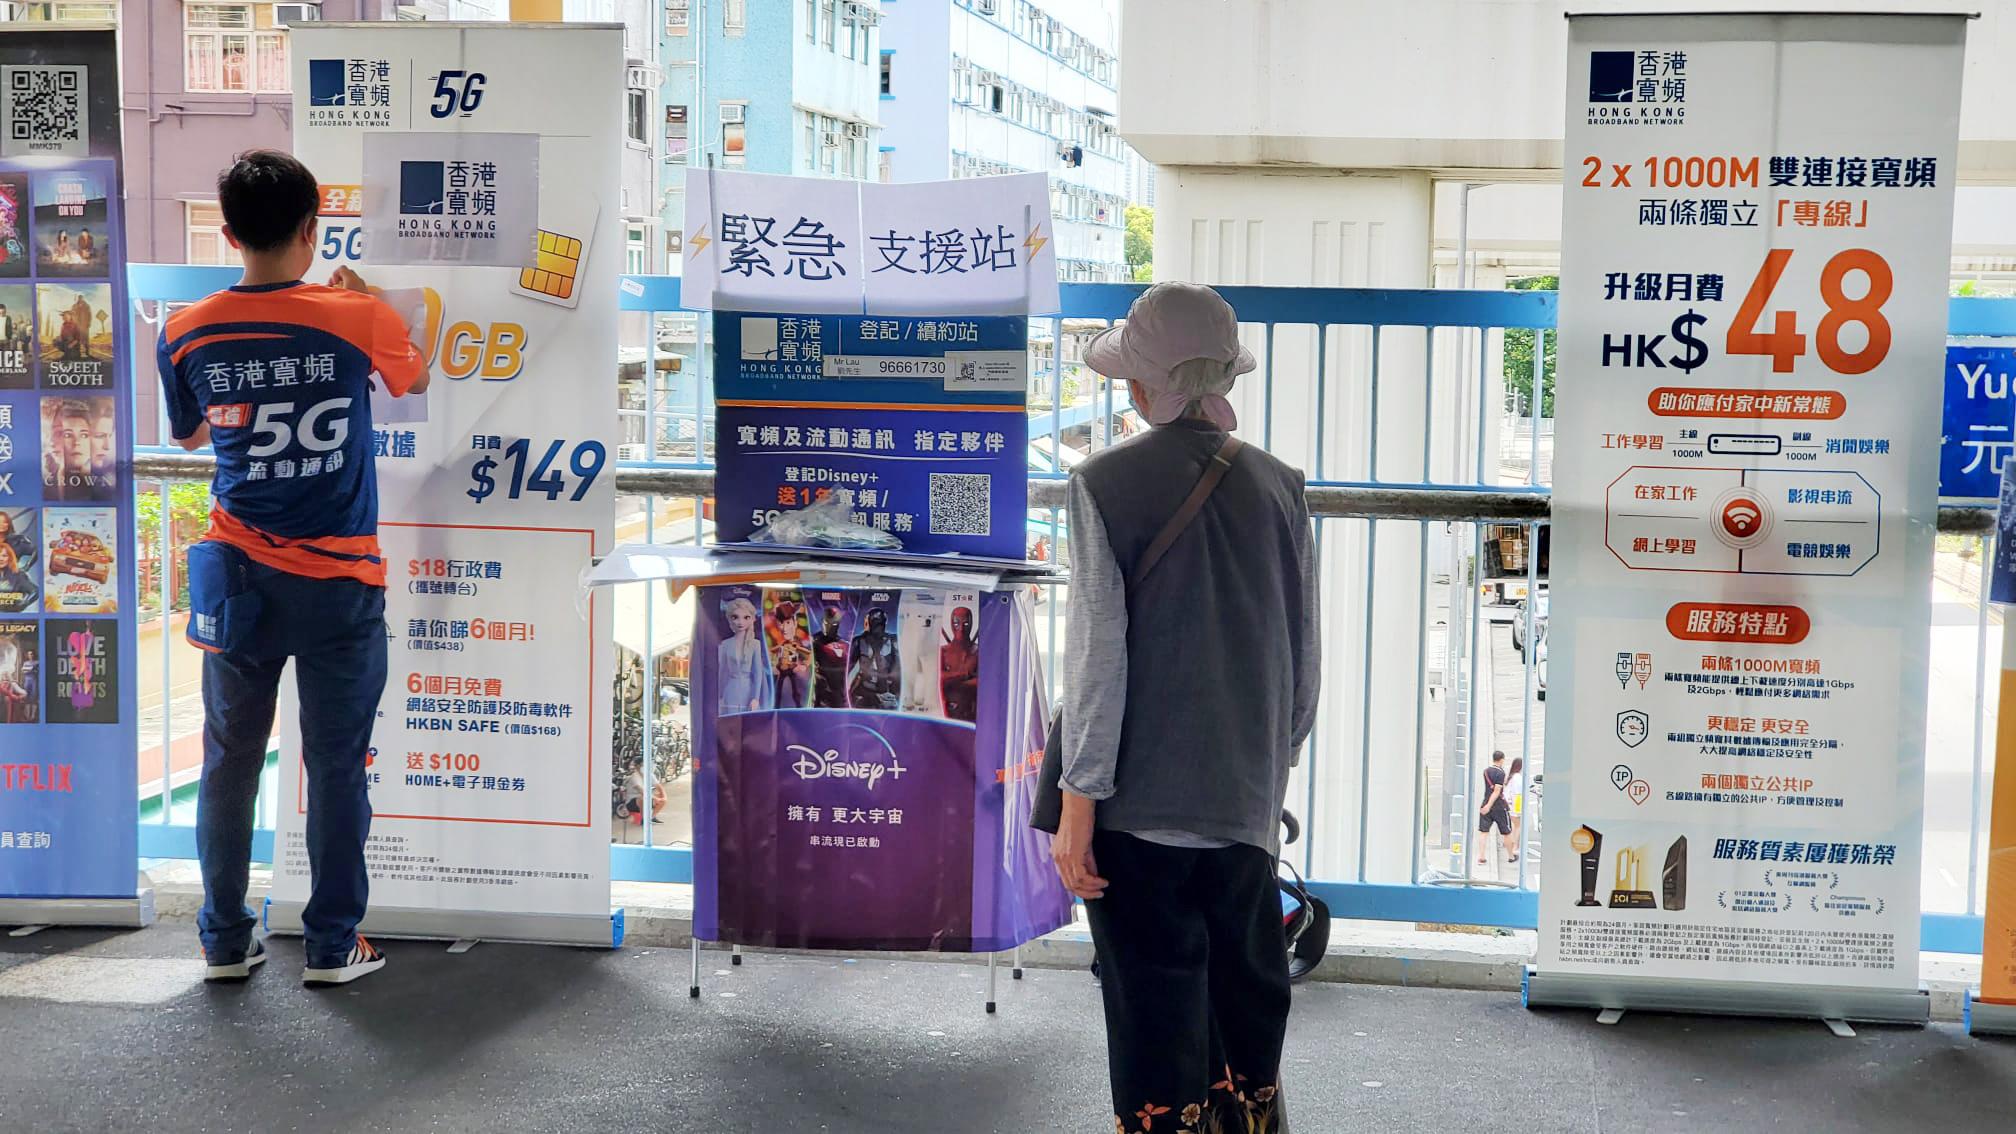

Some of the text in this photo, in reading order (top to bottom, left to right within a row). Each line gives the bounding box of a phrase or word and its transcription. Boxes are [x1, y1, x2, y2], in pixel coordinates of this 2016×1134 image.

[347, 59, 391, 83] 香港
[1636, 50, 1688, 77] 香港
[347, 84, 391, 107] 寬頻
[430, 70, 487, 119] 5G
[1635, 77, 1687, 103] 寬頻
[309, 110, 391, 120] HONG KONG
[1587, 107, 1686, 118] HONG KONG
[446, 161, 497, 188] 香港
[1581, 156, 1937, 189] 2 x 1000M 雙連接寬頻
[446, 188, 497, 216] 寬頻
[1638, 199, 1759, 227] 兩條獨立
[398, 219, 497, 231] HONG KONG
[453, 231, 496, 239] NETWORK
[720, 212, 1018, 281] 緊急 支援站
[1603, 272, 1724, 302] 升級月費
[1601, 248, 1894, 375] HK$ 48
[779, 317, 823, 341] 香港
[859, 320, 900, 341] 登記
[916, 320, 979, 343] 續約站
[779, 341, 823, 362] 寬頻
[834, 358, 860, 366] Mr Lau
[50, 361, 102, 374] SWEET
[203, 353, 336, 393] 香港寬頻
[740, 364, 823, 374] HONG KONG
[879, 361, 945, 374] 96661730
[48, 374, 104, 386] TOOTH
[1957, 363, 2016, 399] Yu
[1657, 392, 1833, 415] 助你應付家中新常態
[246, 397, 353, 458] 5G
[472, 435, 502, 450] 月費
[736, 425, 1005, 453] 寬頻及流動通訊 指定夥伴
[1600, 433, 1664, 450] 工作學習
[1672, 449, 1704, 458] 1000M
[1785, 452, 1817, 461] 1000M
[246, 449, 344, 481] 流動通訊
[466, 438, 607, 503] $149
[44, 475, 114, 487] CROWN
[1634, 484, 1698, 502] 在家工作
[1787, 488, 1854, 506] 影視串流
[1632, 536, 1697, 555] 網上學習
[408, 559, 503, 580] $18行政費
[407, 618, 536, 641] 請你睇6個月!
[1686, 609, 1790, 637] 服務特點
[1701, 655, 1821, 675] 兩條1000M寬頻
[406, 672, 503, 698] 6個月免費
[405, 697, 574, 719] 網絡安全防護及防毒軟件
[405, 717, 453, 731] HKBN
[457, 719, 501, 733] SAFE
[1707, 715, 1810, 735] 更穩定 更安全
[406, 751, 481, 772] 送 $100
[405, 774, 527, 792] HOME+電子現金券
[1616, 771, 1629, 781] IP
[1701, 773, 1814, 793] 兩個獨立公共IP
[1633, 785, 1646, 796] IP
[787, 804, 904, 825] 擁有 更大宇宙
[1712, 838, 1897, 866] 服務質素屢獲殊榮
